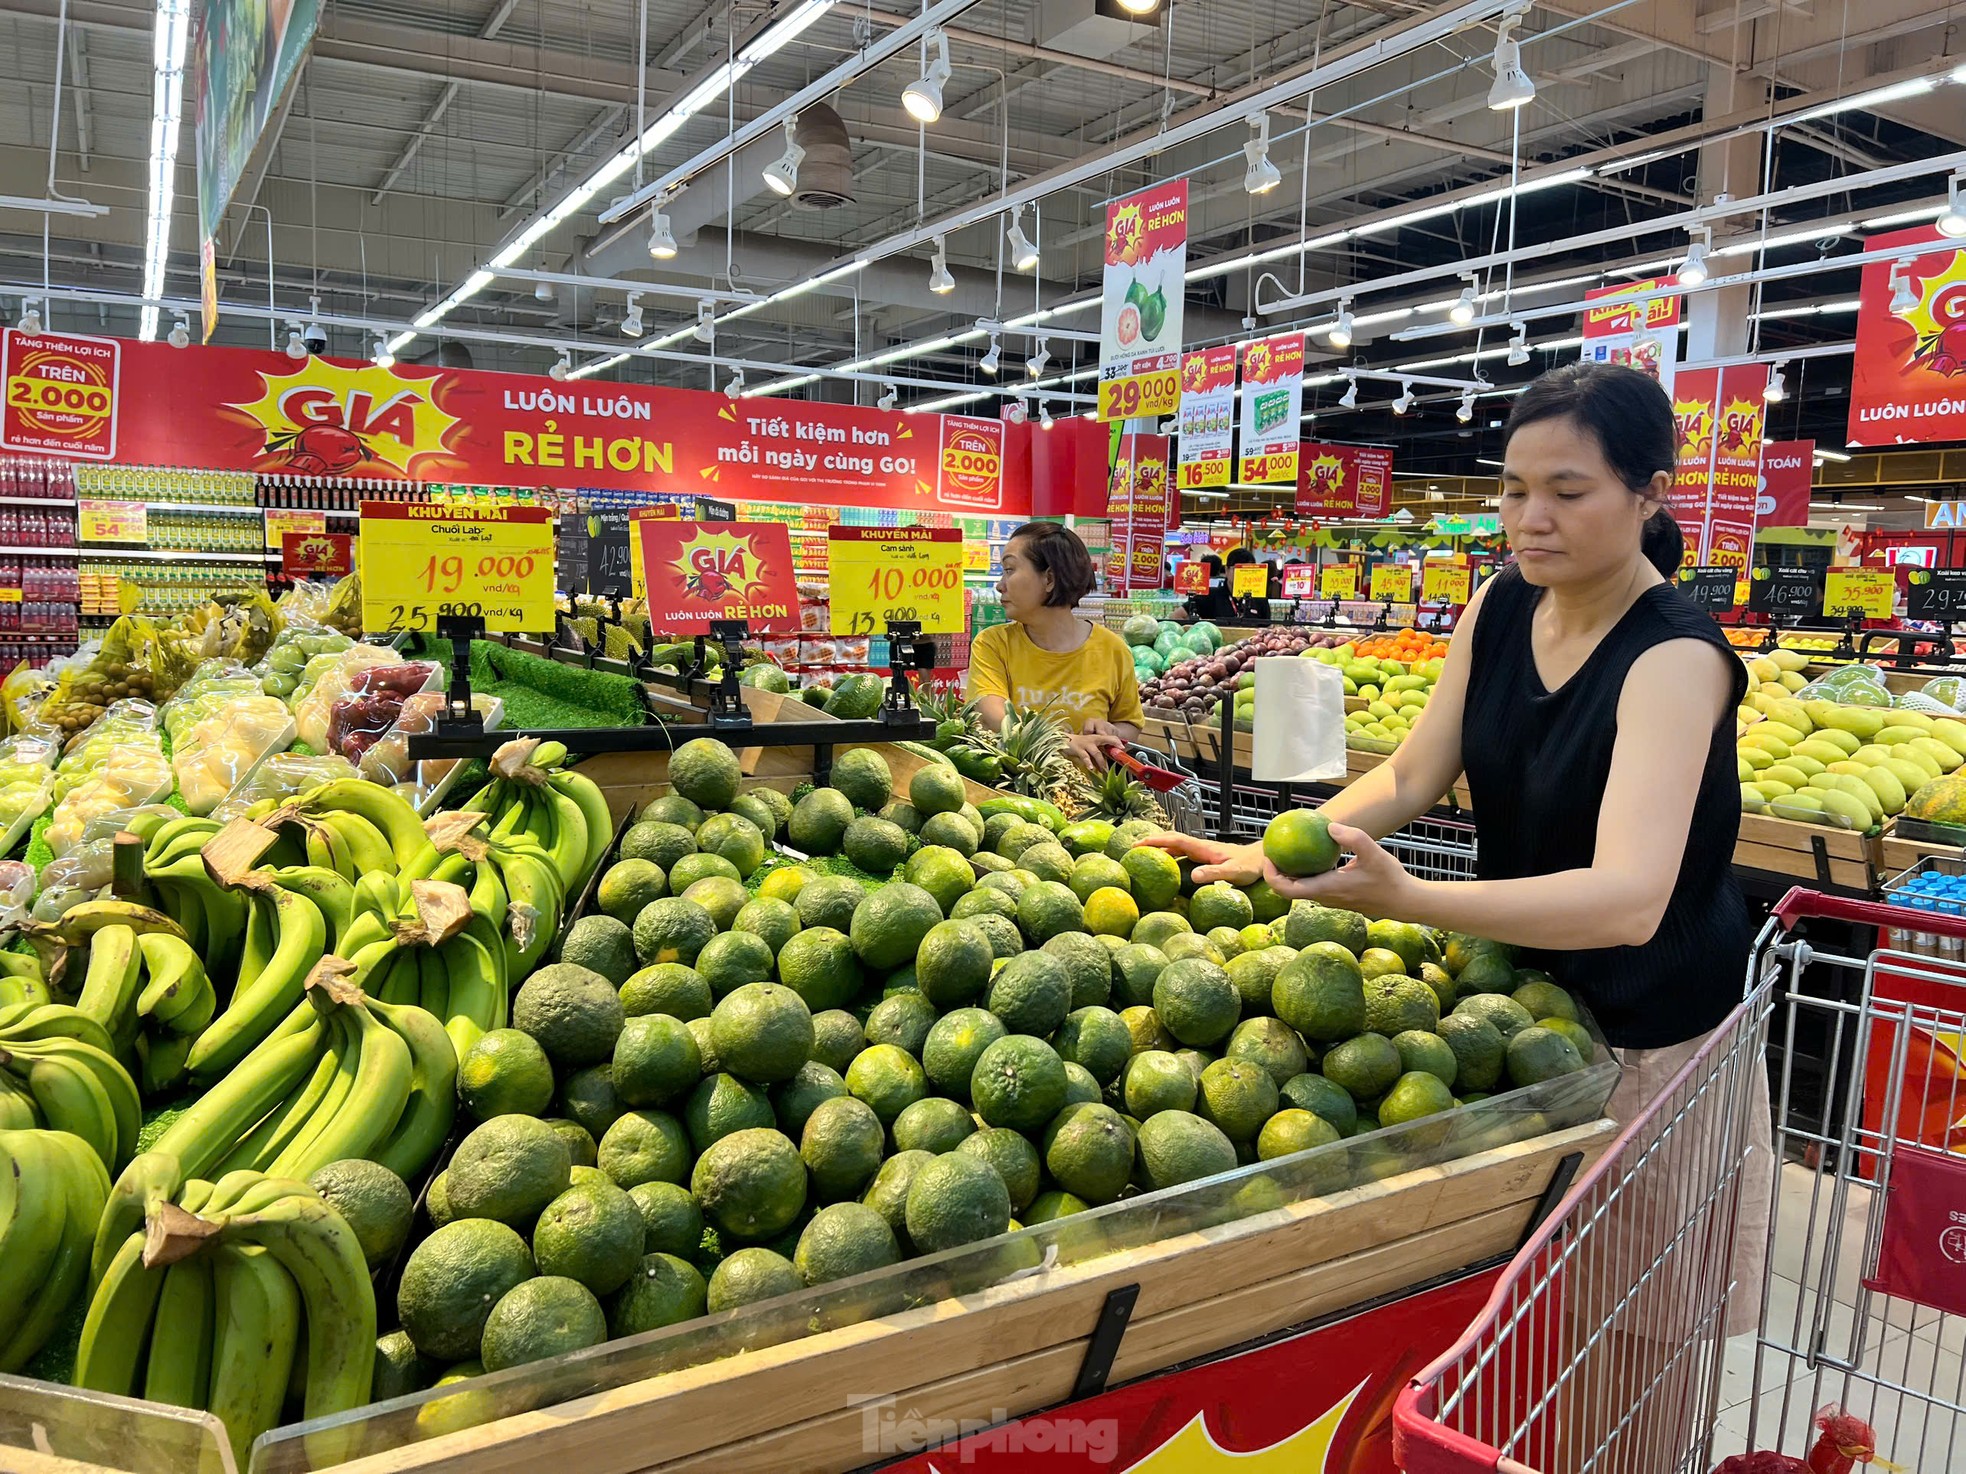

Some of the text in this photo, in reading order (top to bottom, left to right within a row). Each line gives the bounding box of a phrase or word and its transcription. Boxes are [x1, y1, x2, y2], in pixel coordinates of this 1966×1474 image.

[1115, 214, 1138, 237] GIÁ
[1148, 210, 1184, 231] RẺ HƠN
[45, 342, 72, 353] THÊM
[75, 345, 91, 356] LỢI
[94, 348, 111, 358] ÍCH
[1286, 351, 1302, 361] HƠN
[38, 365, 85, 382] TRÊN
[12, 382, 108, 412] 2.000
[504, 388, 650, 420] LUÔN LUÔN
[1107, 377, 1176, 418] 29.000
[36, 411, 83, 424] Sản phẩm
[278, 385, 425, 448] GIÁ
[1860, 398, 1966, 422] LUÔN LUÔN
[747, 417, 890, 446] Tiết kiệm hơn
[1726, 412, 1755, 438] GIÁ
[23, 435, 41, 445] hơn
[43, 436, 61, 447] đến
[63, 439, 82, 449] cuối
[84, 442, 105, 452] năm
[504, 420, 673, 474] RẺ HƠN
[960, 440, 986, 452] TRÊN
[718, 440, 916, 475] mỗi ngày cùng GO!
[945, 453, 997, 474] 2.000
[1683, 456, 1707, 466] LUÔN
[1718, 456, 1756, 468] LUÔN LUÔN
[1766, 455, 1801, 470] TOÁN
[1140, 466, 1161, 480] GIÁ
[1184, 462, 1224, 485] 16.500
[1243, 456, 1292, 481] 54.000
[1315, 464, 1339, 483] GIÁ
[1714, 467, 1757, 487] RẺ HƠN
[1675, 471, 1708, 486] HƠN
[1132, 500, 1165, 513] RẺ HƠN
[1324, 497, 1334, 508] RẺ
[1335, 499, 1353, 509] HƠN
[95, 523, 119, 537] 54
[431, 523, 460, 534] Chuối
[861, 528, 932, 540] KHUYẾN MÃI
[881, 544, 897, 552] Cam
[1722, 540, 1739, 552] TRÊN
[690, 544, 747, 581] GIÁ
[665, 600, 788, 621] LUÔN LUÔN RẺ HƠN
